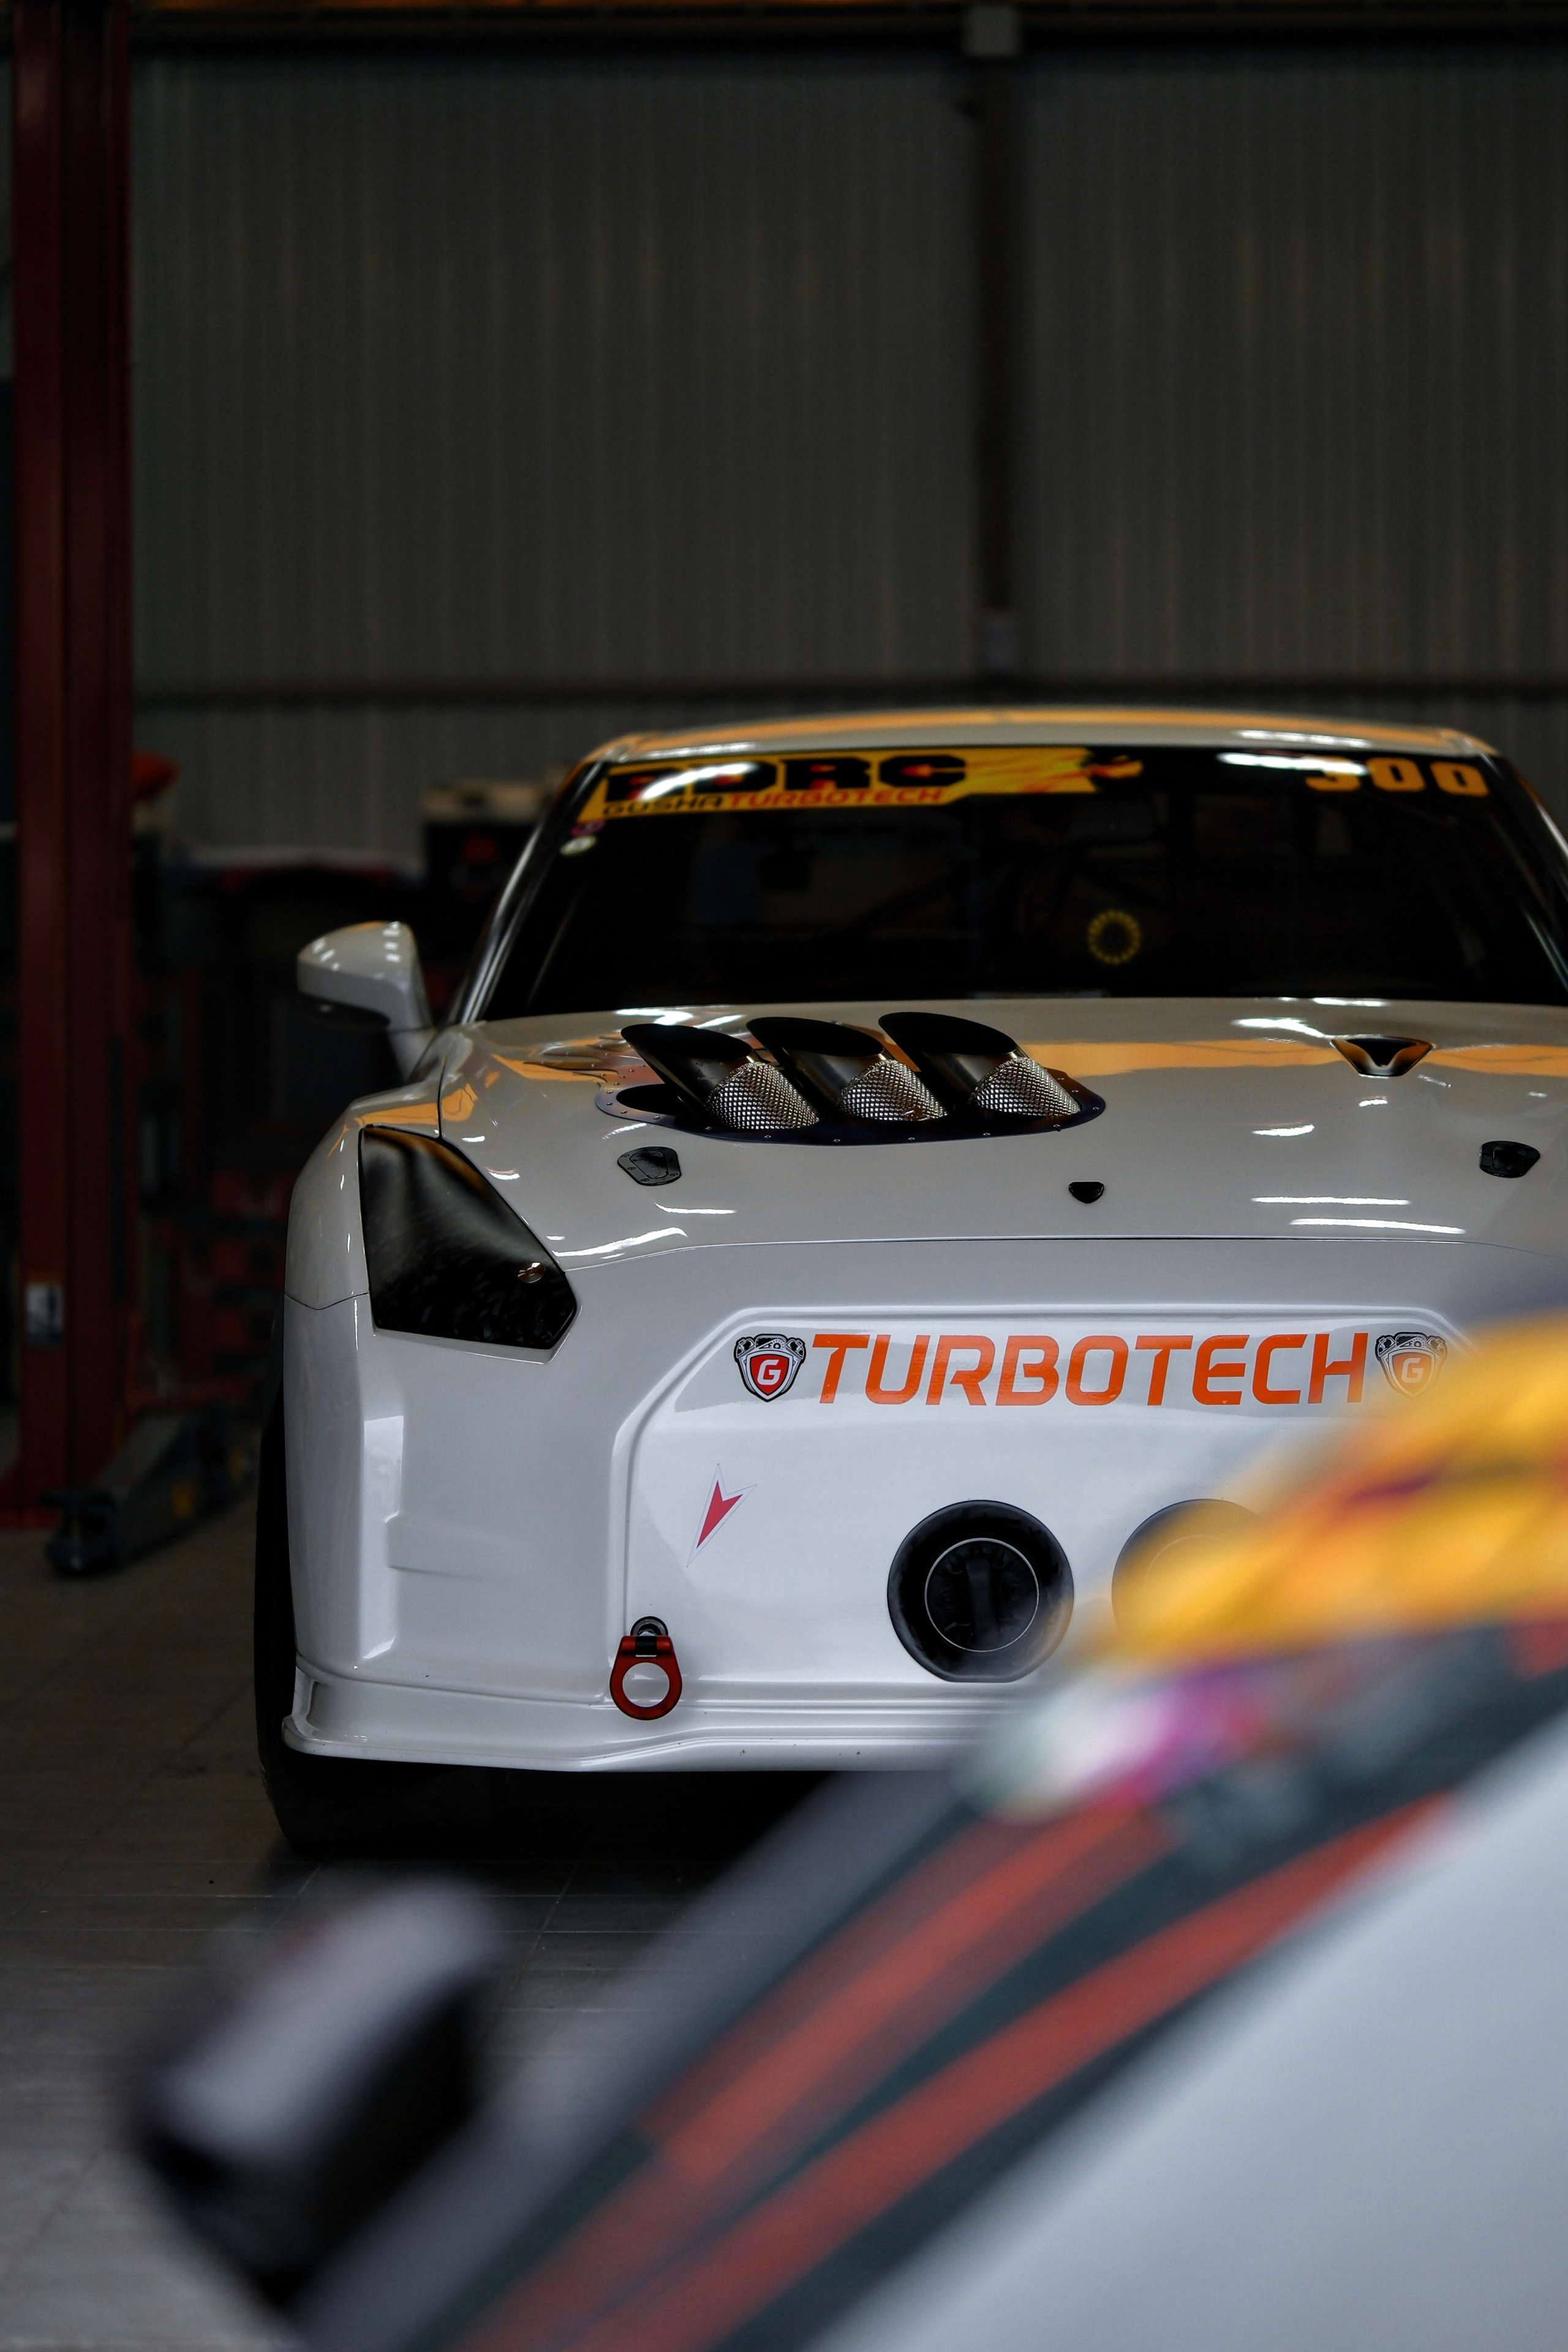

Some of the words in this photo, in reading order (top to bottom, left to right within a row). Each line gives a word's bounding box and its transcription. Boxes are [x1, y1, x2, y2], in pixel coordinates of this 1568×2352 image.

[730, 788, 944, 809] TURBOTECH
[756, 1359, 782, 1385] G
[812, 1333, 1368, 1406] TURBOTECH
[1401, 1357, 1424, 1383] G
